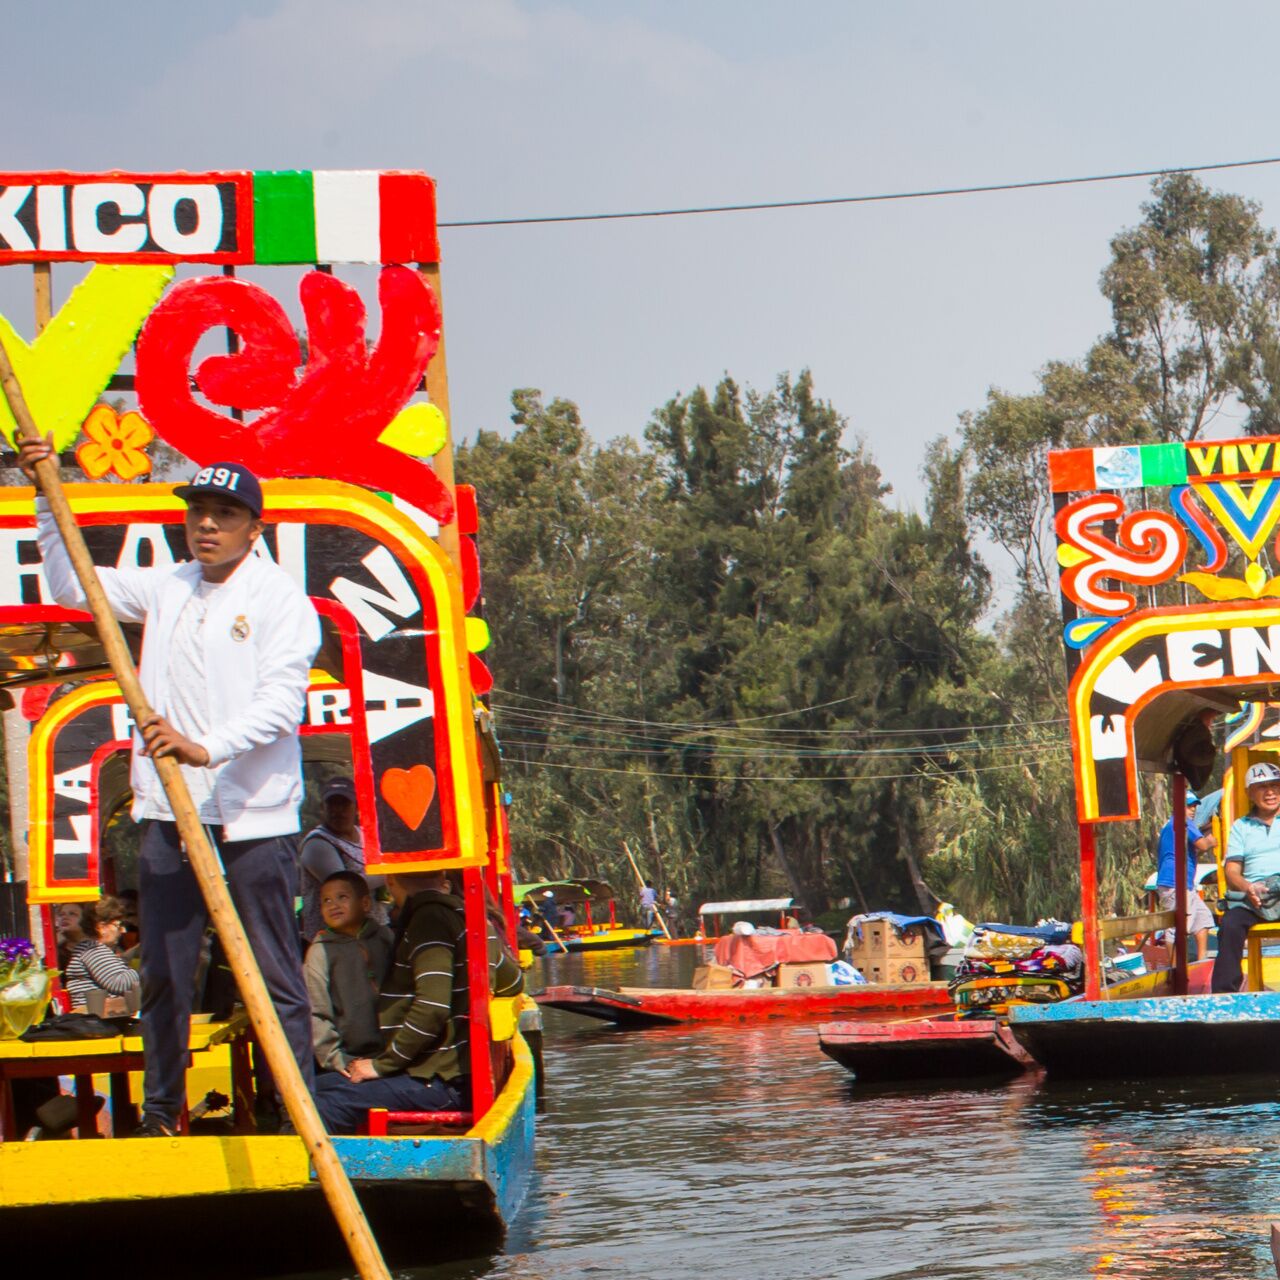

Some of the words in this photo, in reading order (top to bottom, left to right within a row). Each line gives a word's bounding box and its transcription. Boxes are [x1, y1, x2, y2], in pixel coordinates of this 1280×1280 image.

[192, 466, 240, 491] 1991
[1252, 767, 1267, 778] LA
[54, 763, 91, 854] LA
